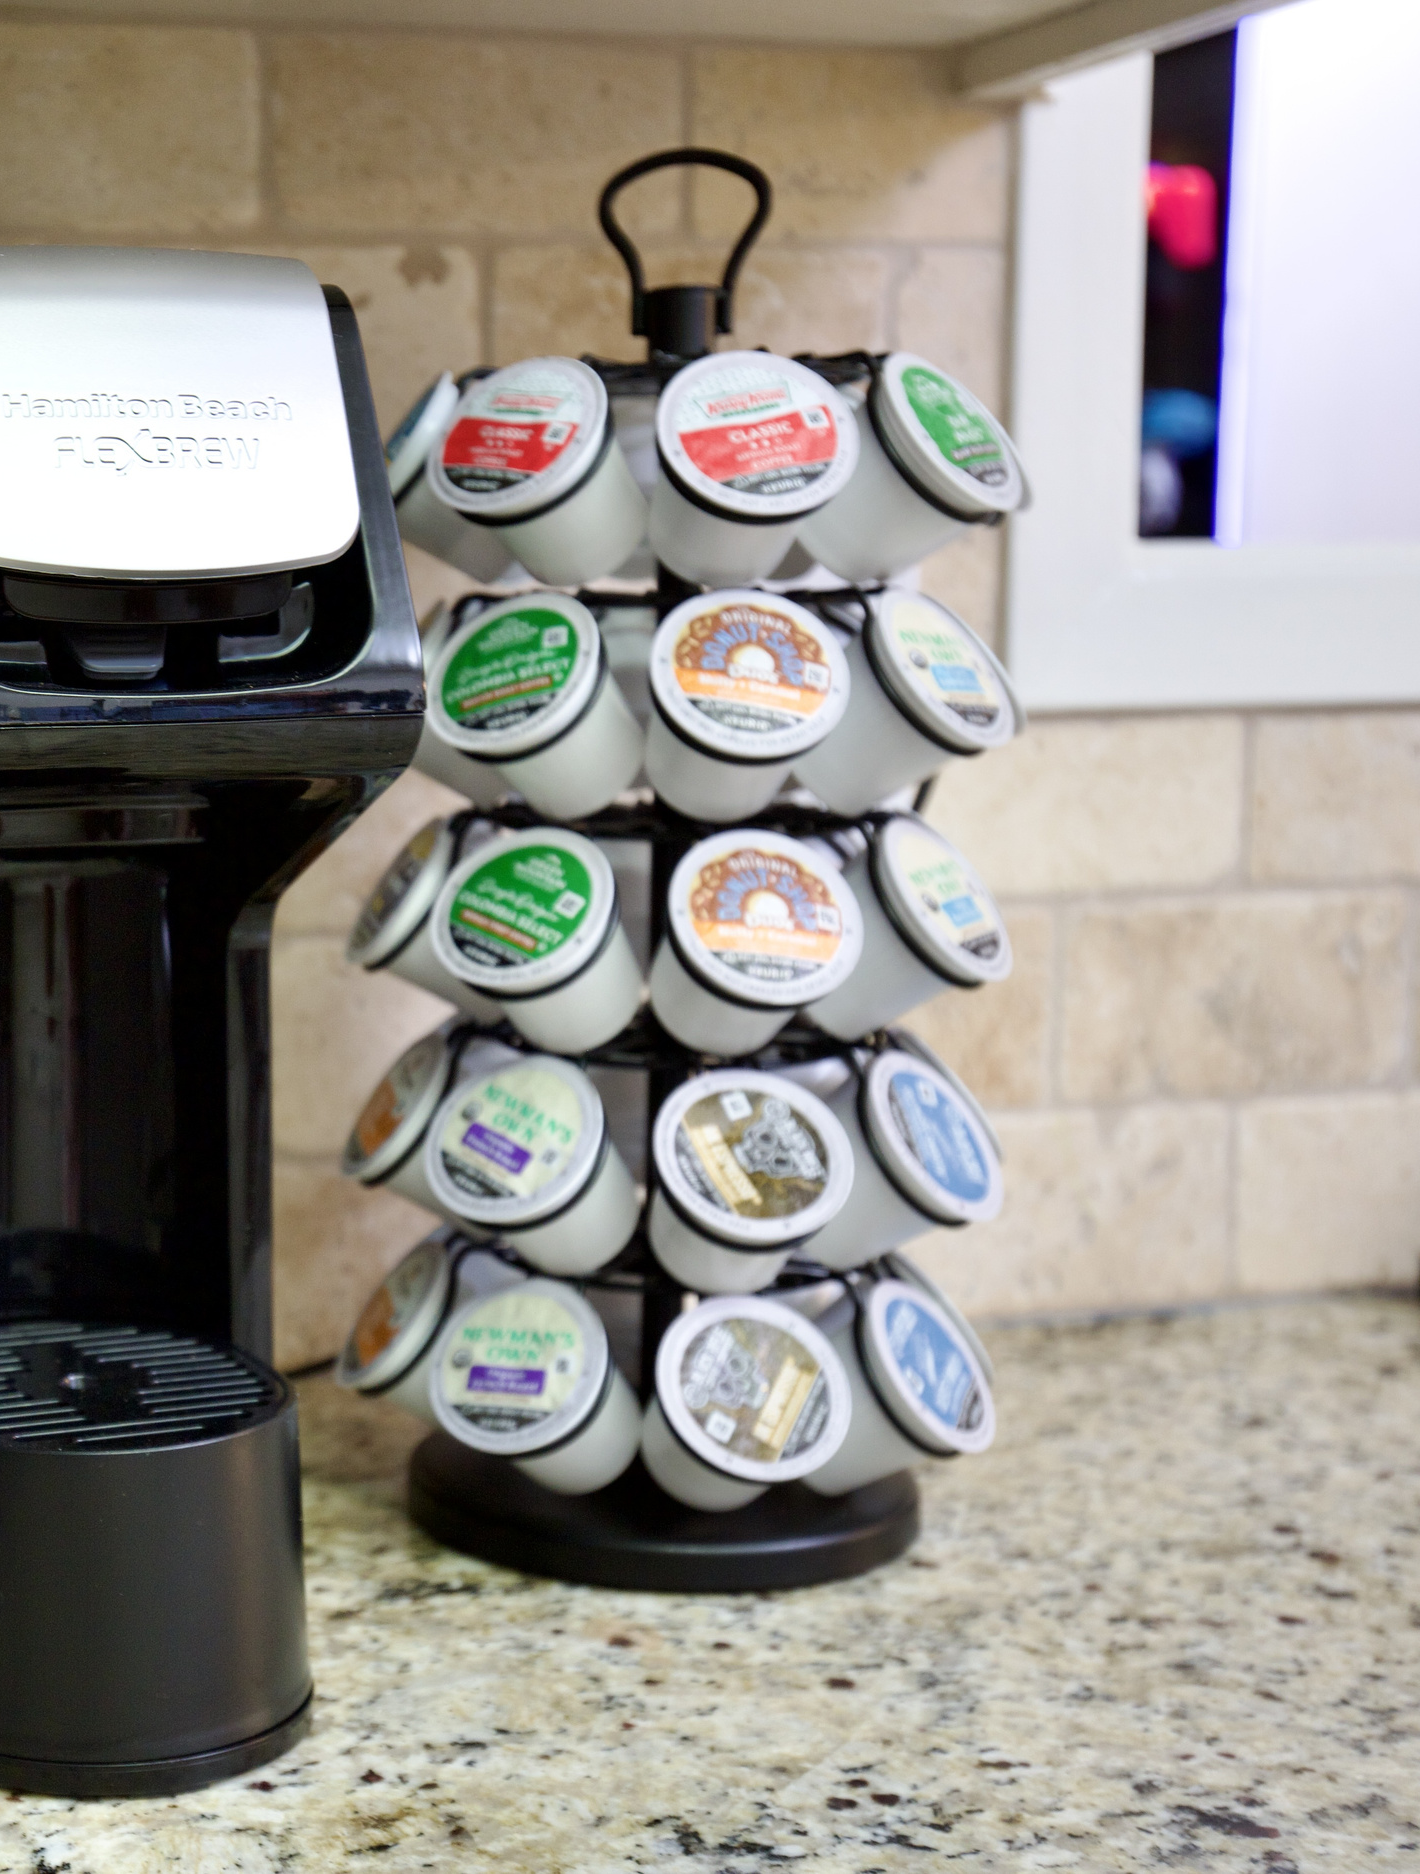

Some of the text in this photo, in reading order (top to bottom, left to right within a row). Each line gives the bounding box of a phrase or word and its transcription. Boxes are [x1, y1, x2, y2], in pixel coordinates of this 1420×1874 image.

[2, 393, 293, 421] Hamilton Beach
[727, 419, 795, 444] CLASSIC
[700, 622, 760, 669] DONUT
